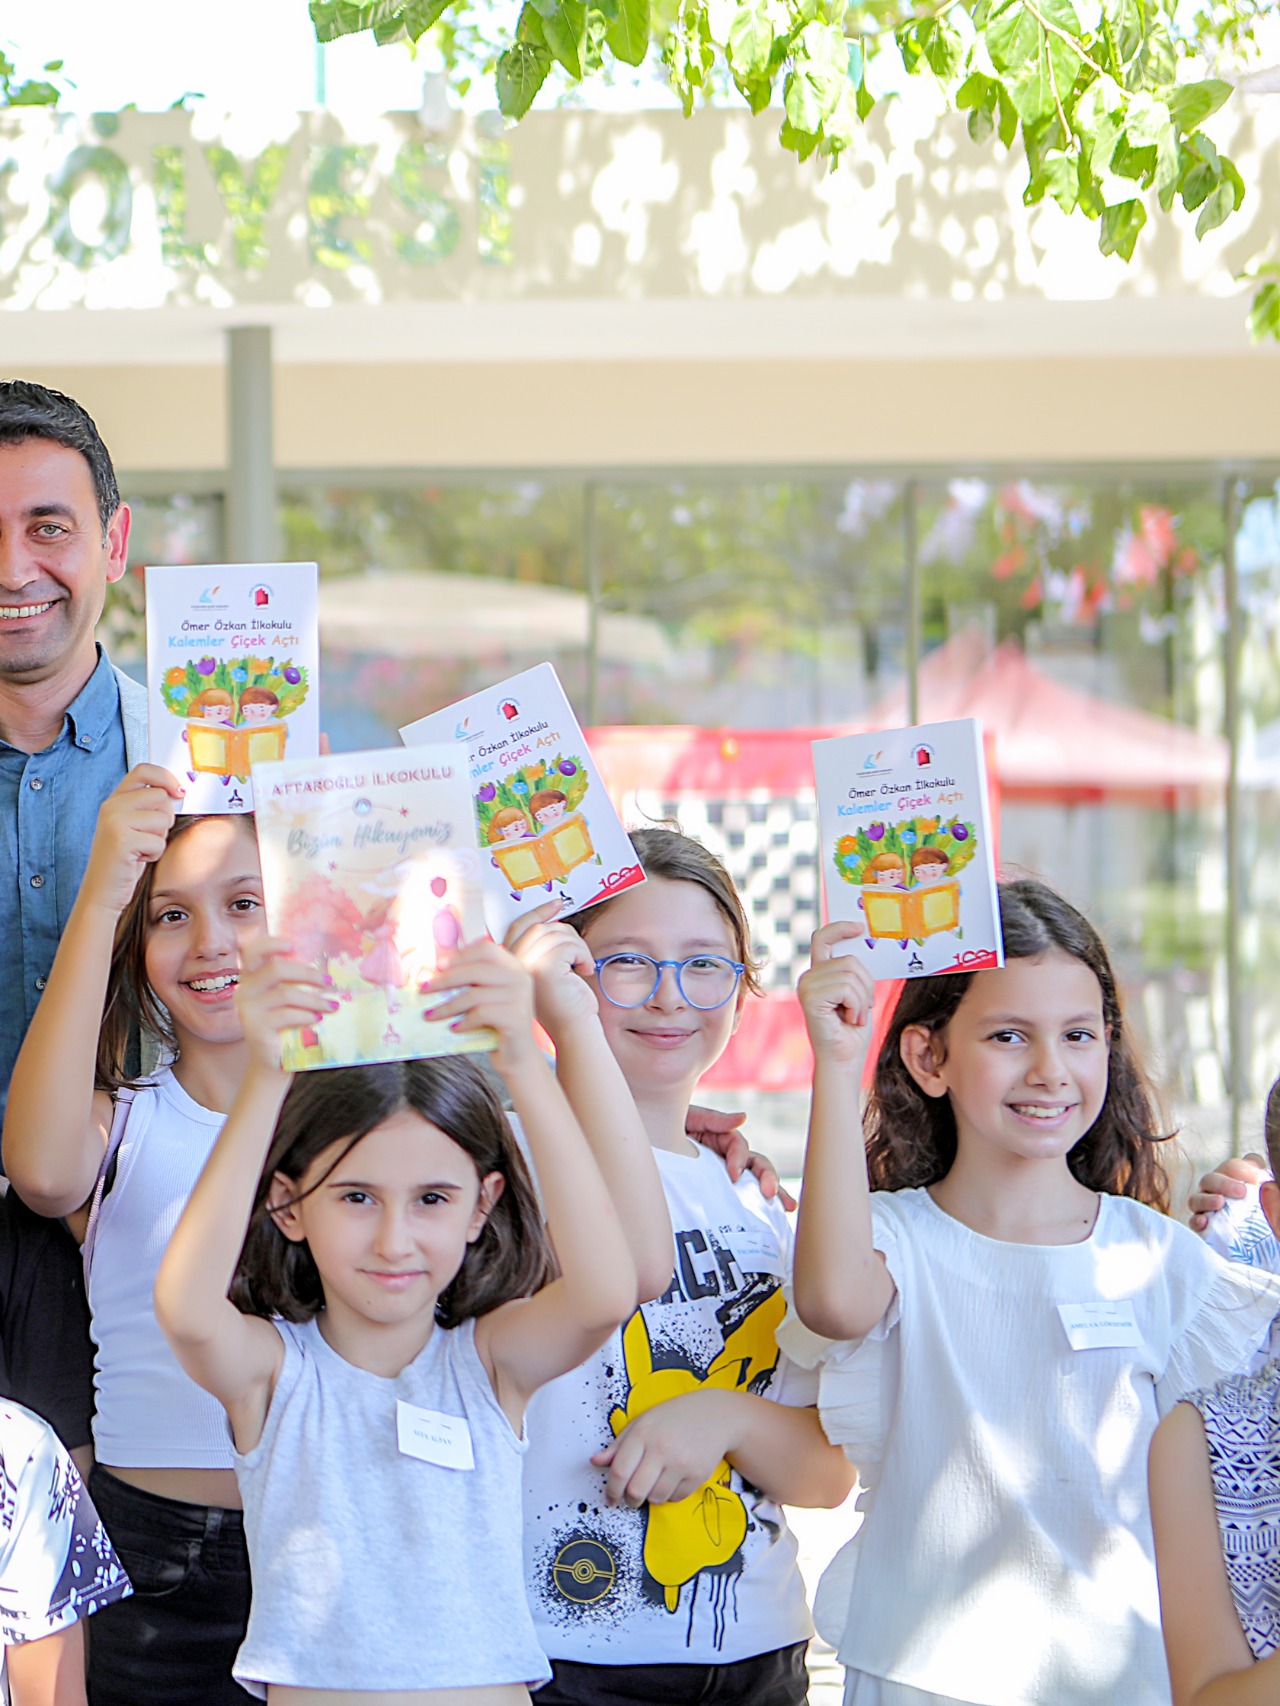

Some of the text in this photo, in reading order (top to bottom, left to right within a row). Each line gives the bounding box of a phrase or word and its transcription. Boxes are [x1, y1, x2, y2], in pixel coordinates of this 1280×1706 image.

[181, 619, 292, 632] Ömer Özkan İlkokulu
[168, 634, 300, 649] Kalemler Çiçek Açtı
[478, 721, 549, 757] Özkan İlkokulu
[499, 743, 532, 767] Çiçek
[536, 731, 561, 749] Açtı
[372, 766, 454, 786] İLKOKULU
[848, 777, 956, 799] Ömer Özkan İlkokulu
[837, 791, 964, 817] Kalemler Çiçek Açtı
